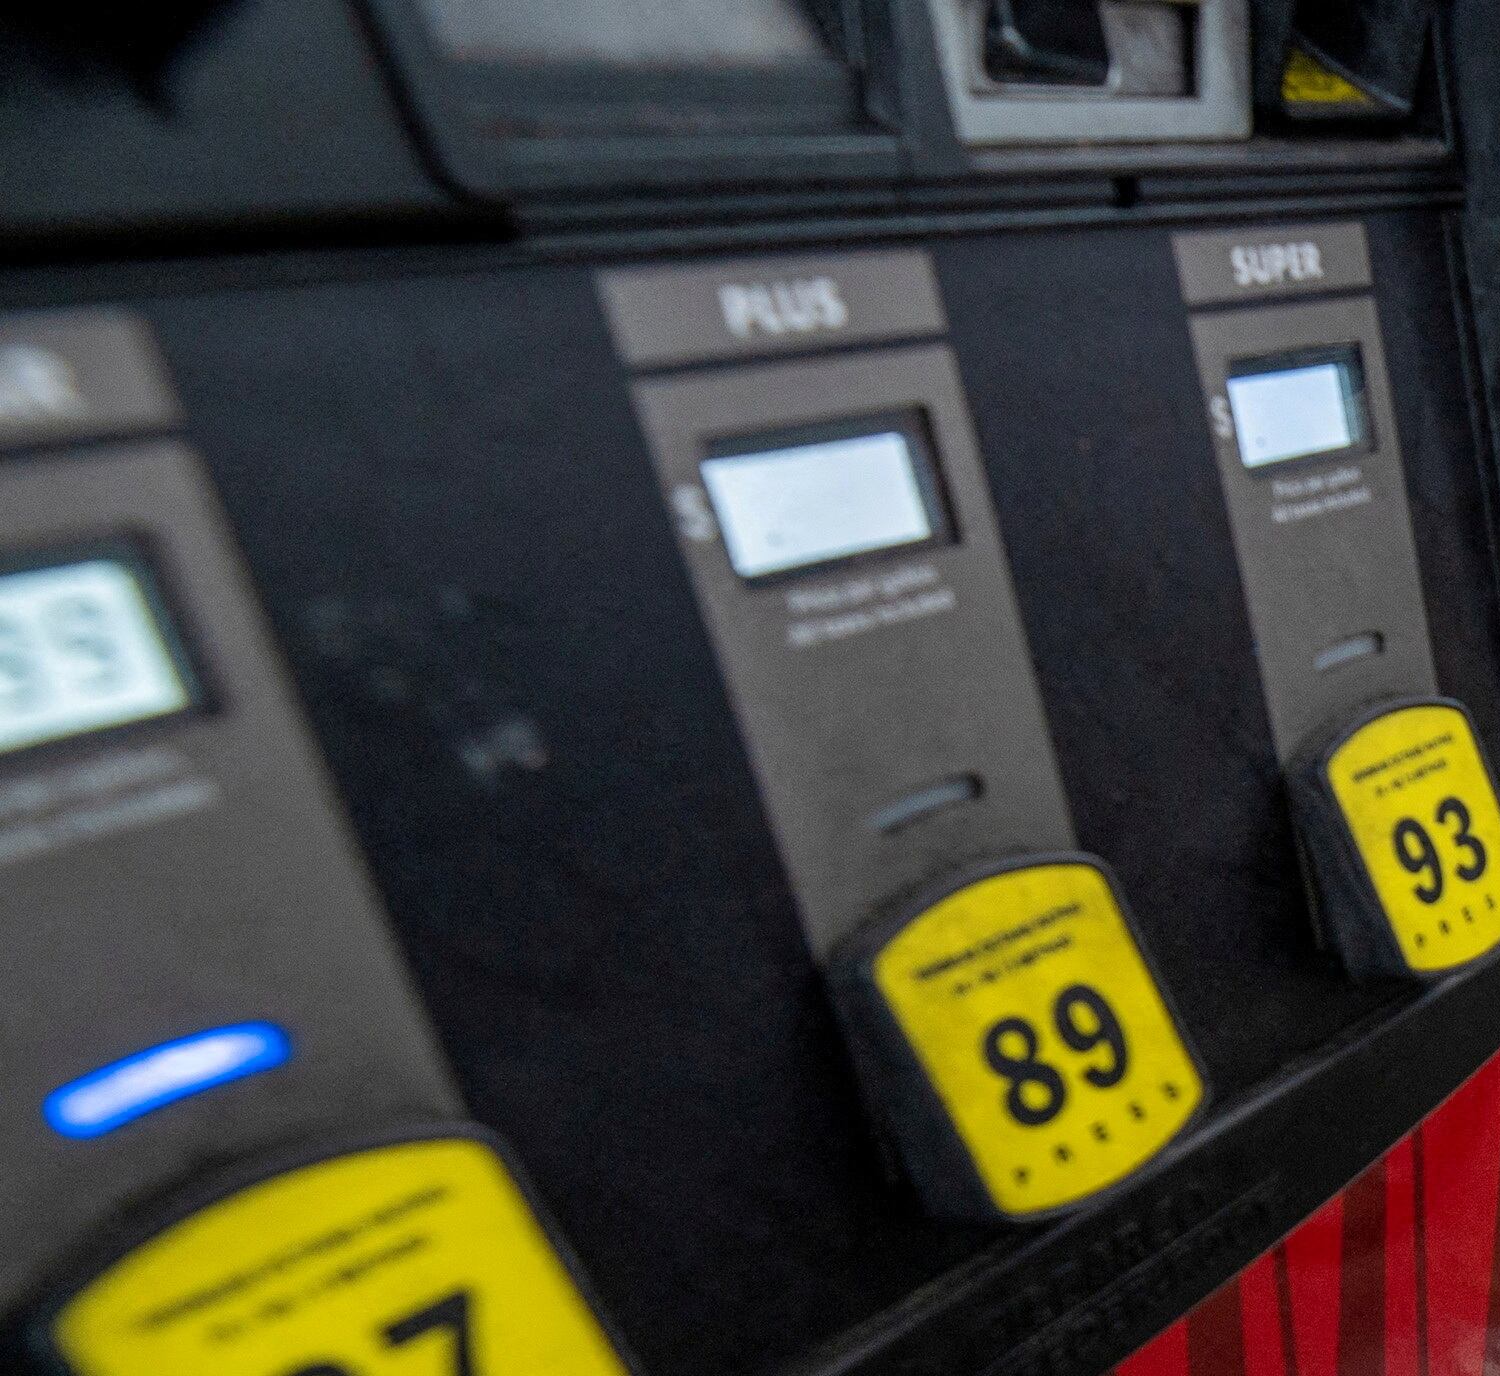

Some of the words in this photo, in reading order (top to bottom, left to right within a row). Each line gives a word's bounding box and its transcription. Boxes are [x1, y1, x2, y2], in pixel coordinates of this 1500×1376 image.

[1231, 241, 1325, 285] SUPER
[718, 278, 848, 339] PLUS
[1391, 795, 1488, 905] 93
[982, 982, 1131, 1129] 89
